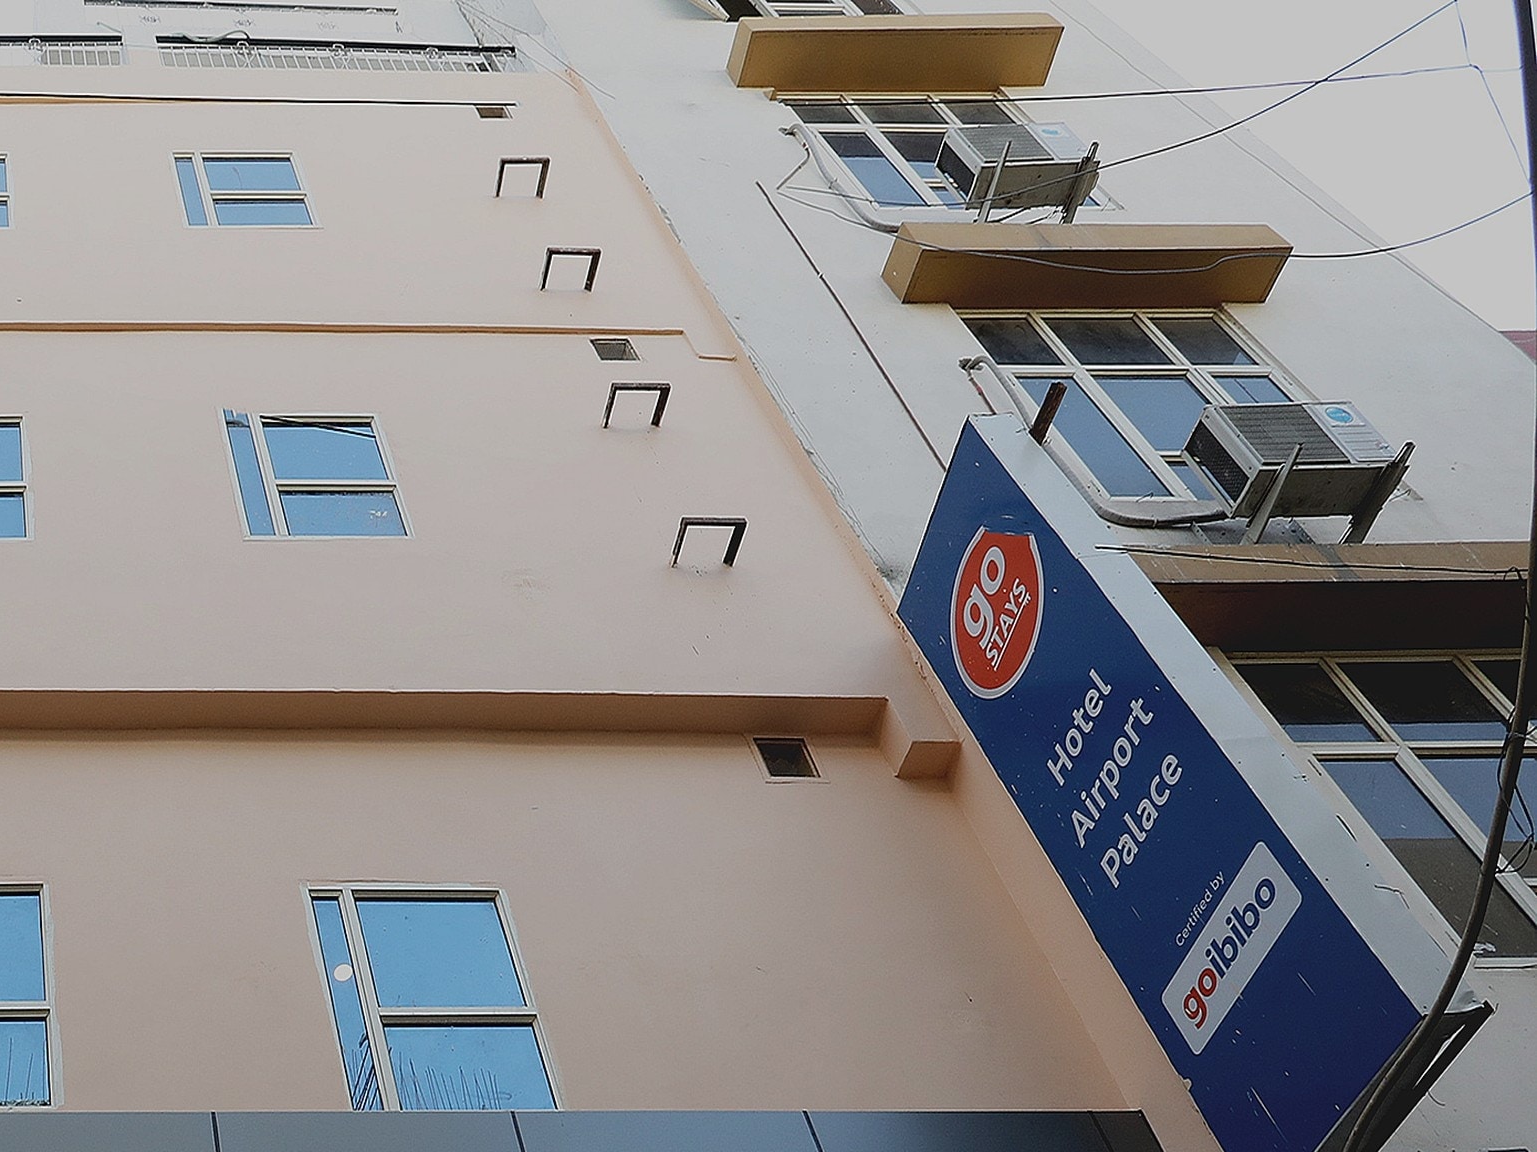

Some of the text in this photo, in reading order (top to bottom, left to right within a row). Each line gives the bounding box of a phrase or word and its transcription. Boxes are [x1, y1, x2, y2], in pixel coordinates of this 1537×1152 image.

[963, 546, 1006, 650] go
[986, 578, 1028, 668] STAYS
[1046, 667, 1112, 787] Hotel
[1070, 697, 1155, 849] Airport
[1099, 753, 1183, 889] Palace
[1175, 871, 1225, 947] Certified by
[1182, 877, 1277, 1030] goibibo
